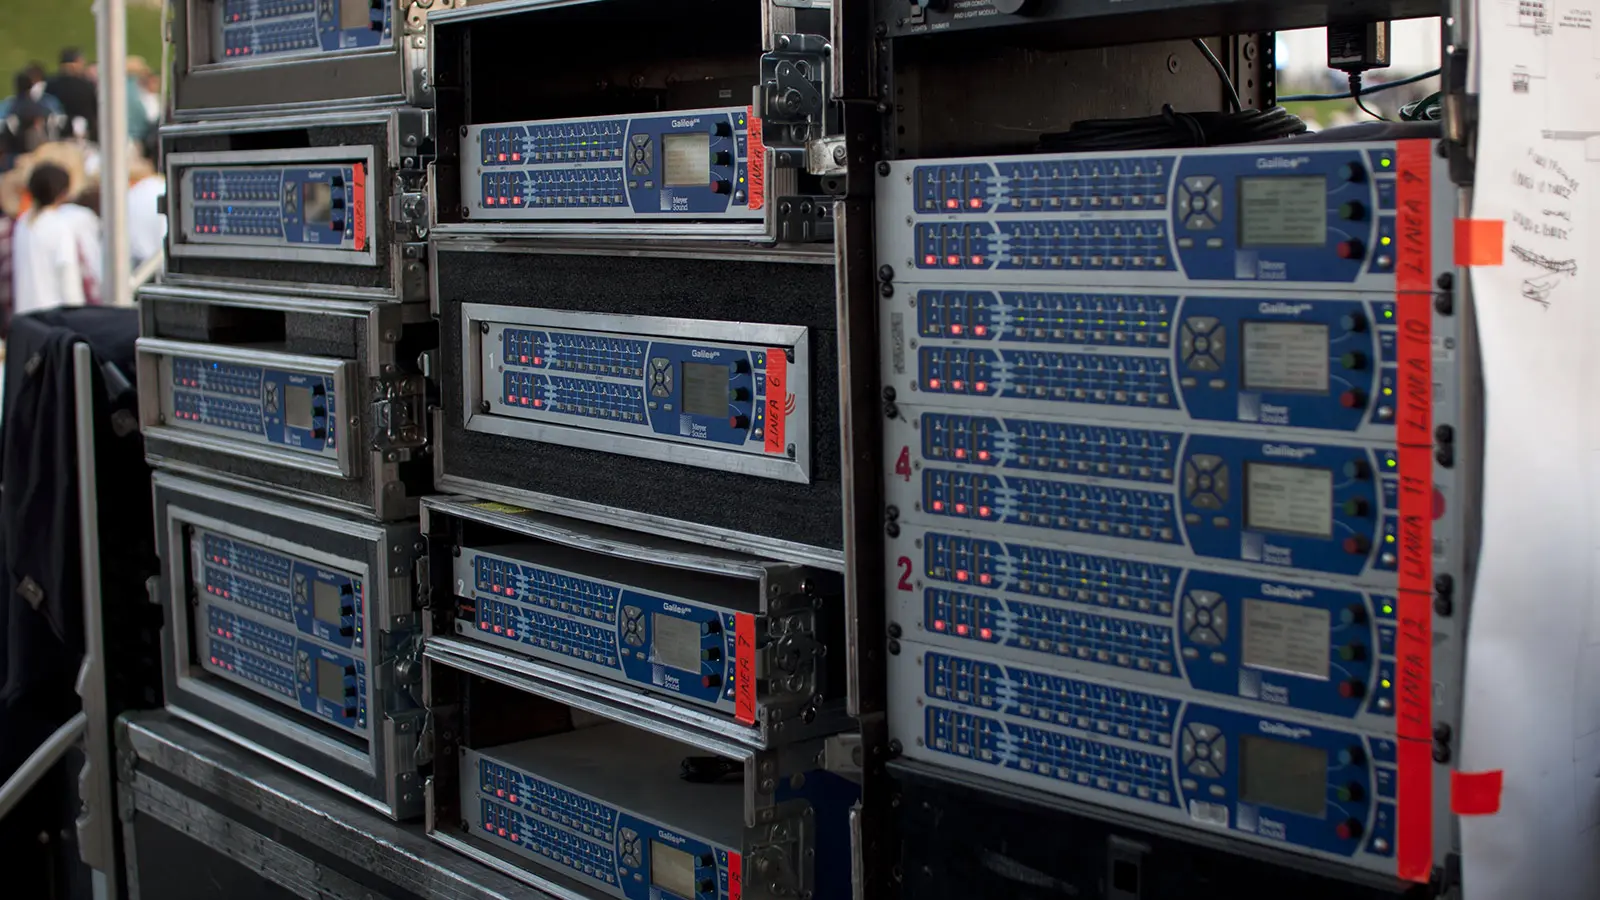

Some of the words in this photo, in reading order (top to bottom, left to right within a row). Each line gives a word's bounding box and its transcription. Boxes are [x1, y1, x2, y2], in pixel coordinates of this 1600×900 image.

[1403, 200, 1425, 274] LINEA
[1404, 319, 1430, 344] 10
[488, 352, 494, 369] 1
[769, 376, 781, 387] 6
[1405, 358, 1429, 432] LINEA
[769, 400, 780, 448] LINEA
[895, 445, 912, 482] 4
[457, 579, 465, 597] 2
[897, 556, 913, 592] 2
[738, 634, 751, 648] 7
[739, 657, 752, 713] LINEA
